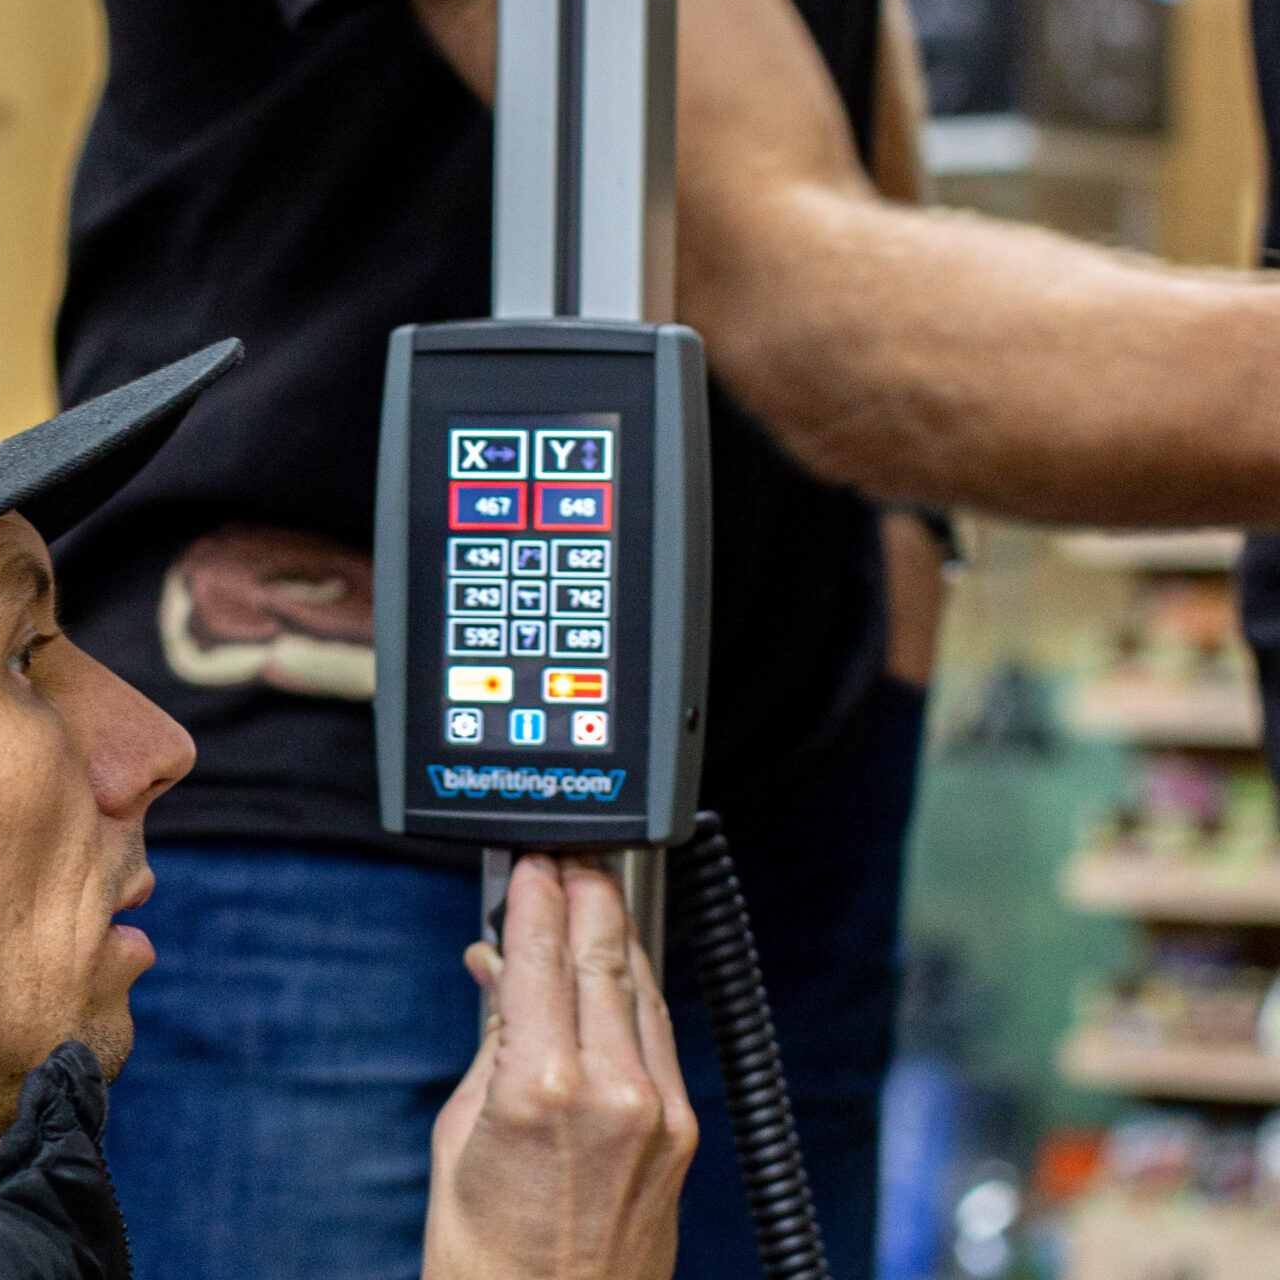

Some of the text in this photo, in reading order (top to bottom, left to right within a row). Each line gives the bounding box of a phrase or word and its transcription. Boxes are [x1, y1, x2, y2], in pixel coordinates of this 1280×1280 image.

[461, 439, 488, 469] X
[549, 439, 577, 470] Y
[475, 496, 513, 517] 467
[559, 497, 597, 518] 648
[568, 548, 604, 569] 622
[567, 588, 603, 609] 742
[443, 768, 612, 798] bikefitting.com
